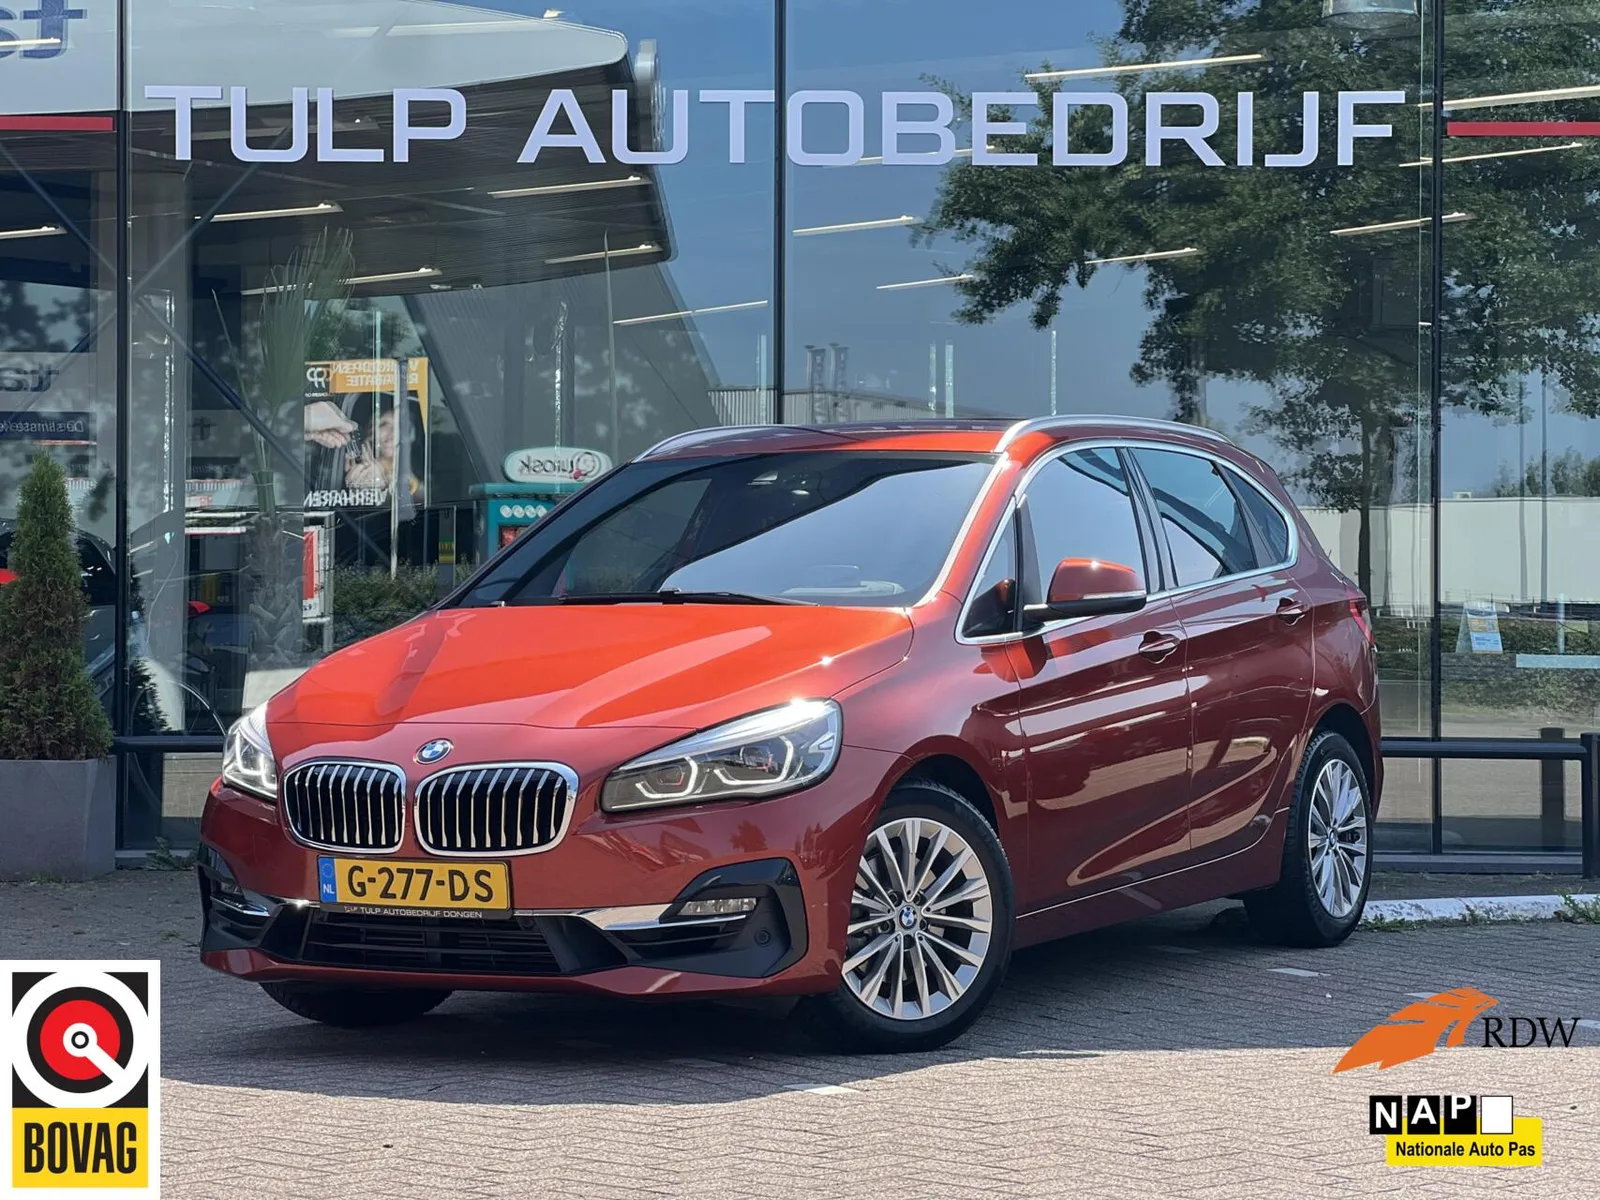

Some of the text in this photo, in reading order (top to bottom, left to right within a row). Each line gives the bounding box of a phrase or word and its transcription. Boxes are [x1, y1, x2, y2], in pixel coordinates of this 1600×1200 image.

[144, 85, 1406, 167] TULP AUTOBEDRIJF
[323, 884, 335, 894] NL
[347, 865, 494, 903] G-277-DS
[360, 906, 381, 914] TULP
[383, 908, 441, 917] AUTOBEDRIJF
[443, 910, 483, 918] DONGEN
